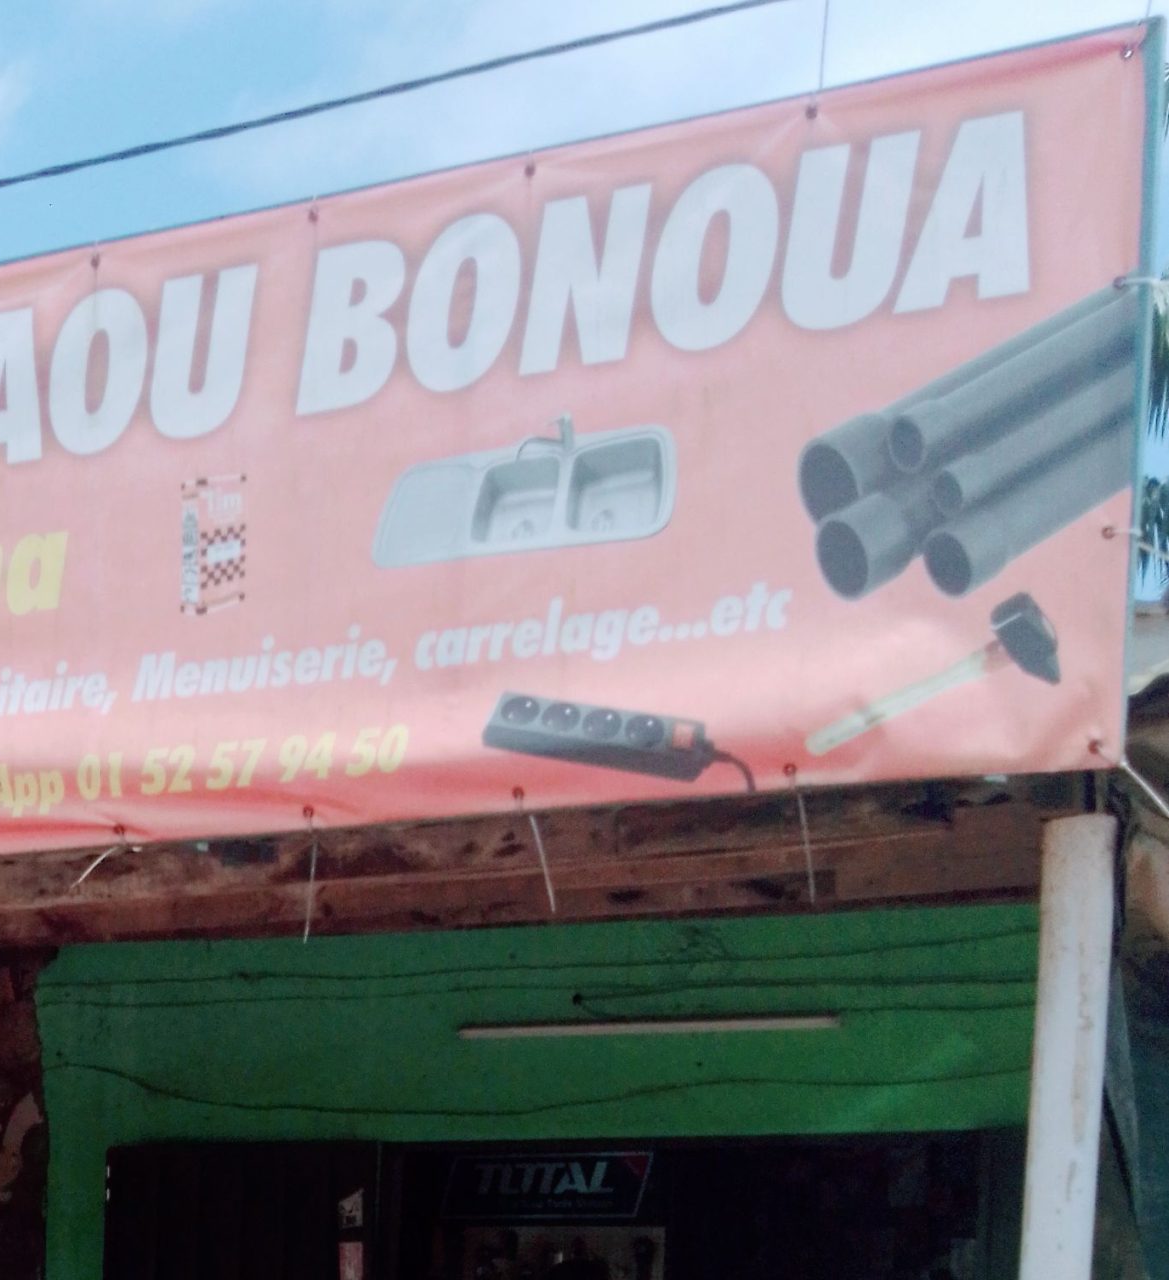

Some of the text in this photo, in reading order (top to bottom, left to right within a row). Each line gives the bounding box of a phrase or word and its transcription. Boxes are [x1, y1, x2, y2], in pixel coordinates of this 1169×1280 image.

[295, 110, 1030, 417] BONOUA
[131, 623, 398, 702] Menuiserie,
[76, 751, 126, 800] 01
[140, 743, 196, 796] 52
[206, 736, 268, 791] 57
[277, 730, 337, 783] 94
[345, 723, 410, 777] 50
